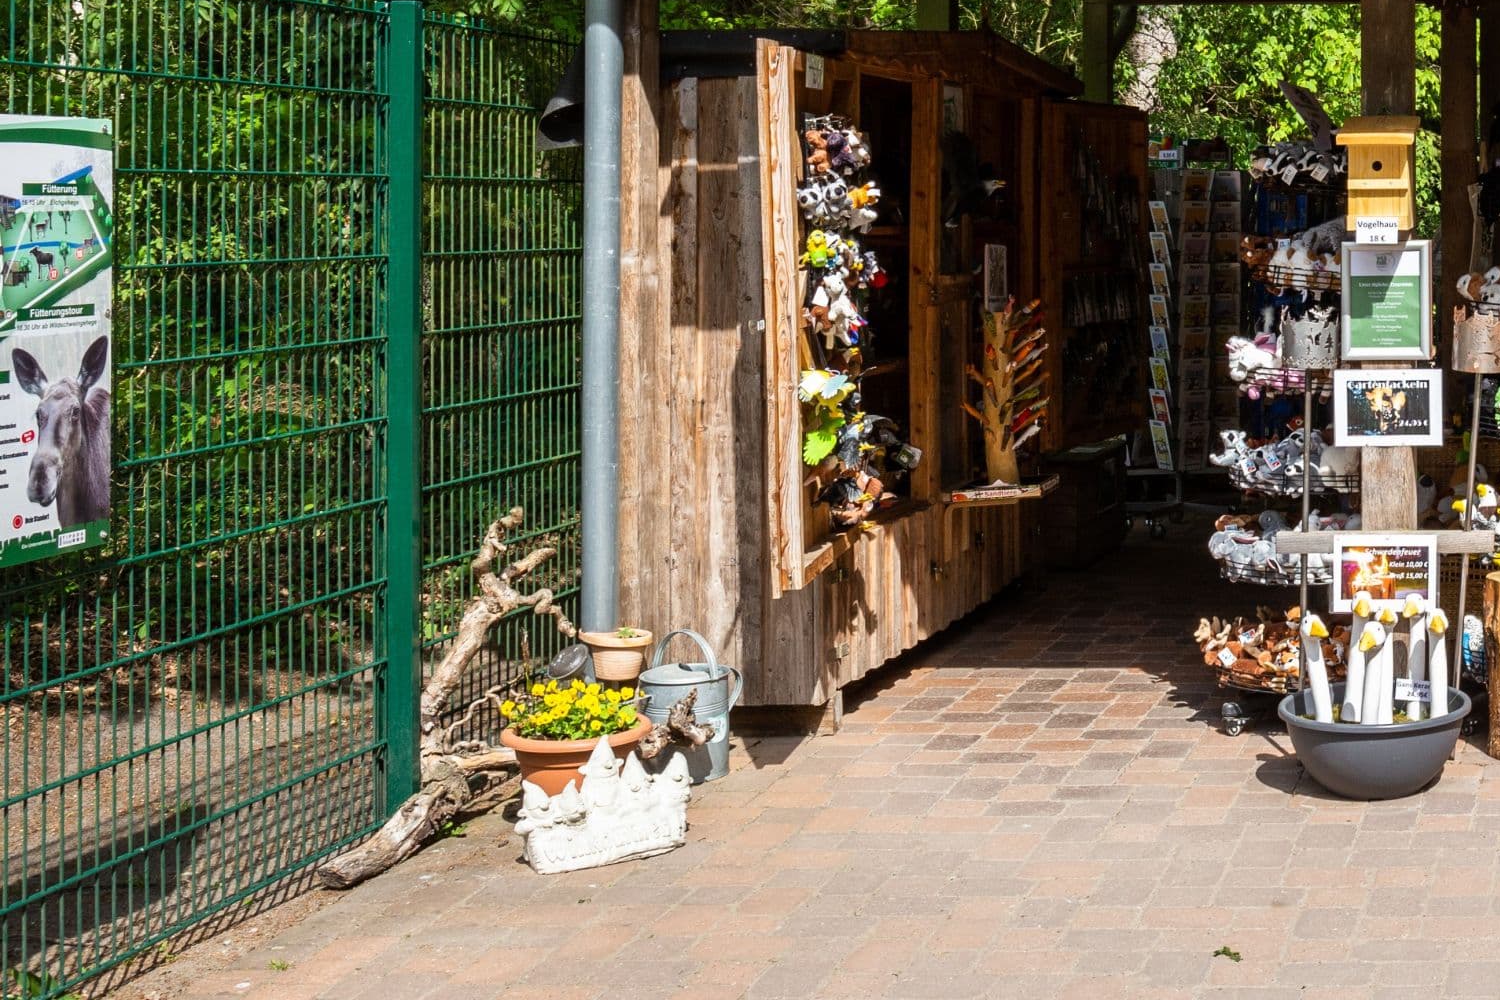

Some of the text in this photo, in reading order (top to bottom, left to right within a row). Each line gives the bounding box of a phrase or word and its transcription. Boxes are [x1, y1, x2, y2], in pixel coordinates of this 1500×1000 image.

[42, 184, 77, 195] Fütterung
[1357, 220, 1398, 229] Vogelhaus
[30, 307, 84, 318] Fütterungstour
[1347, 380, 1428, 389] Gartenfackeln
[1364, 548, 1421, 556] Schwedenfeuer
